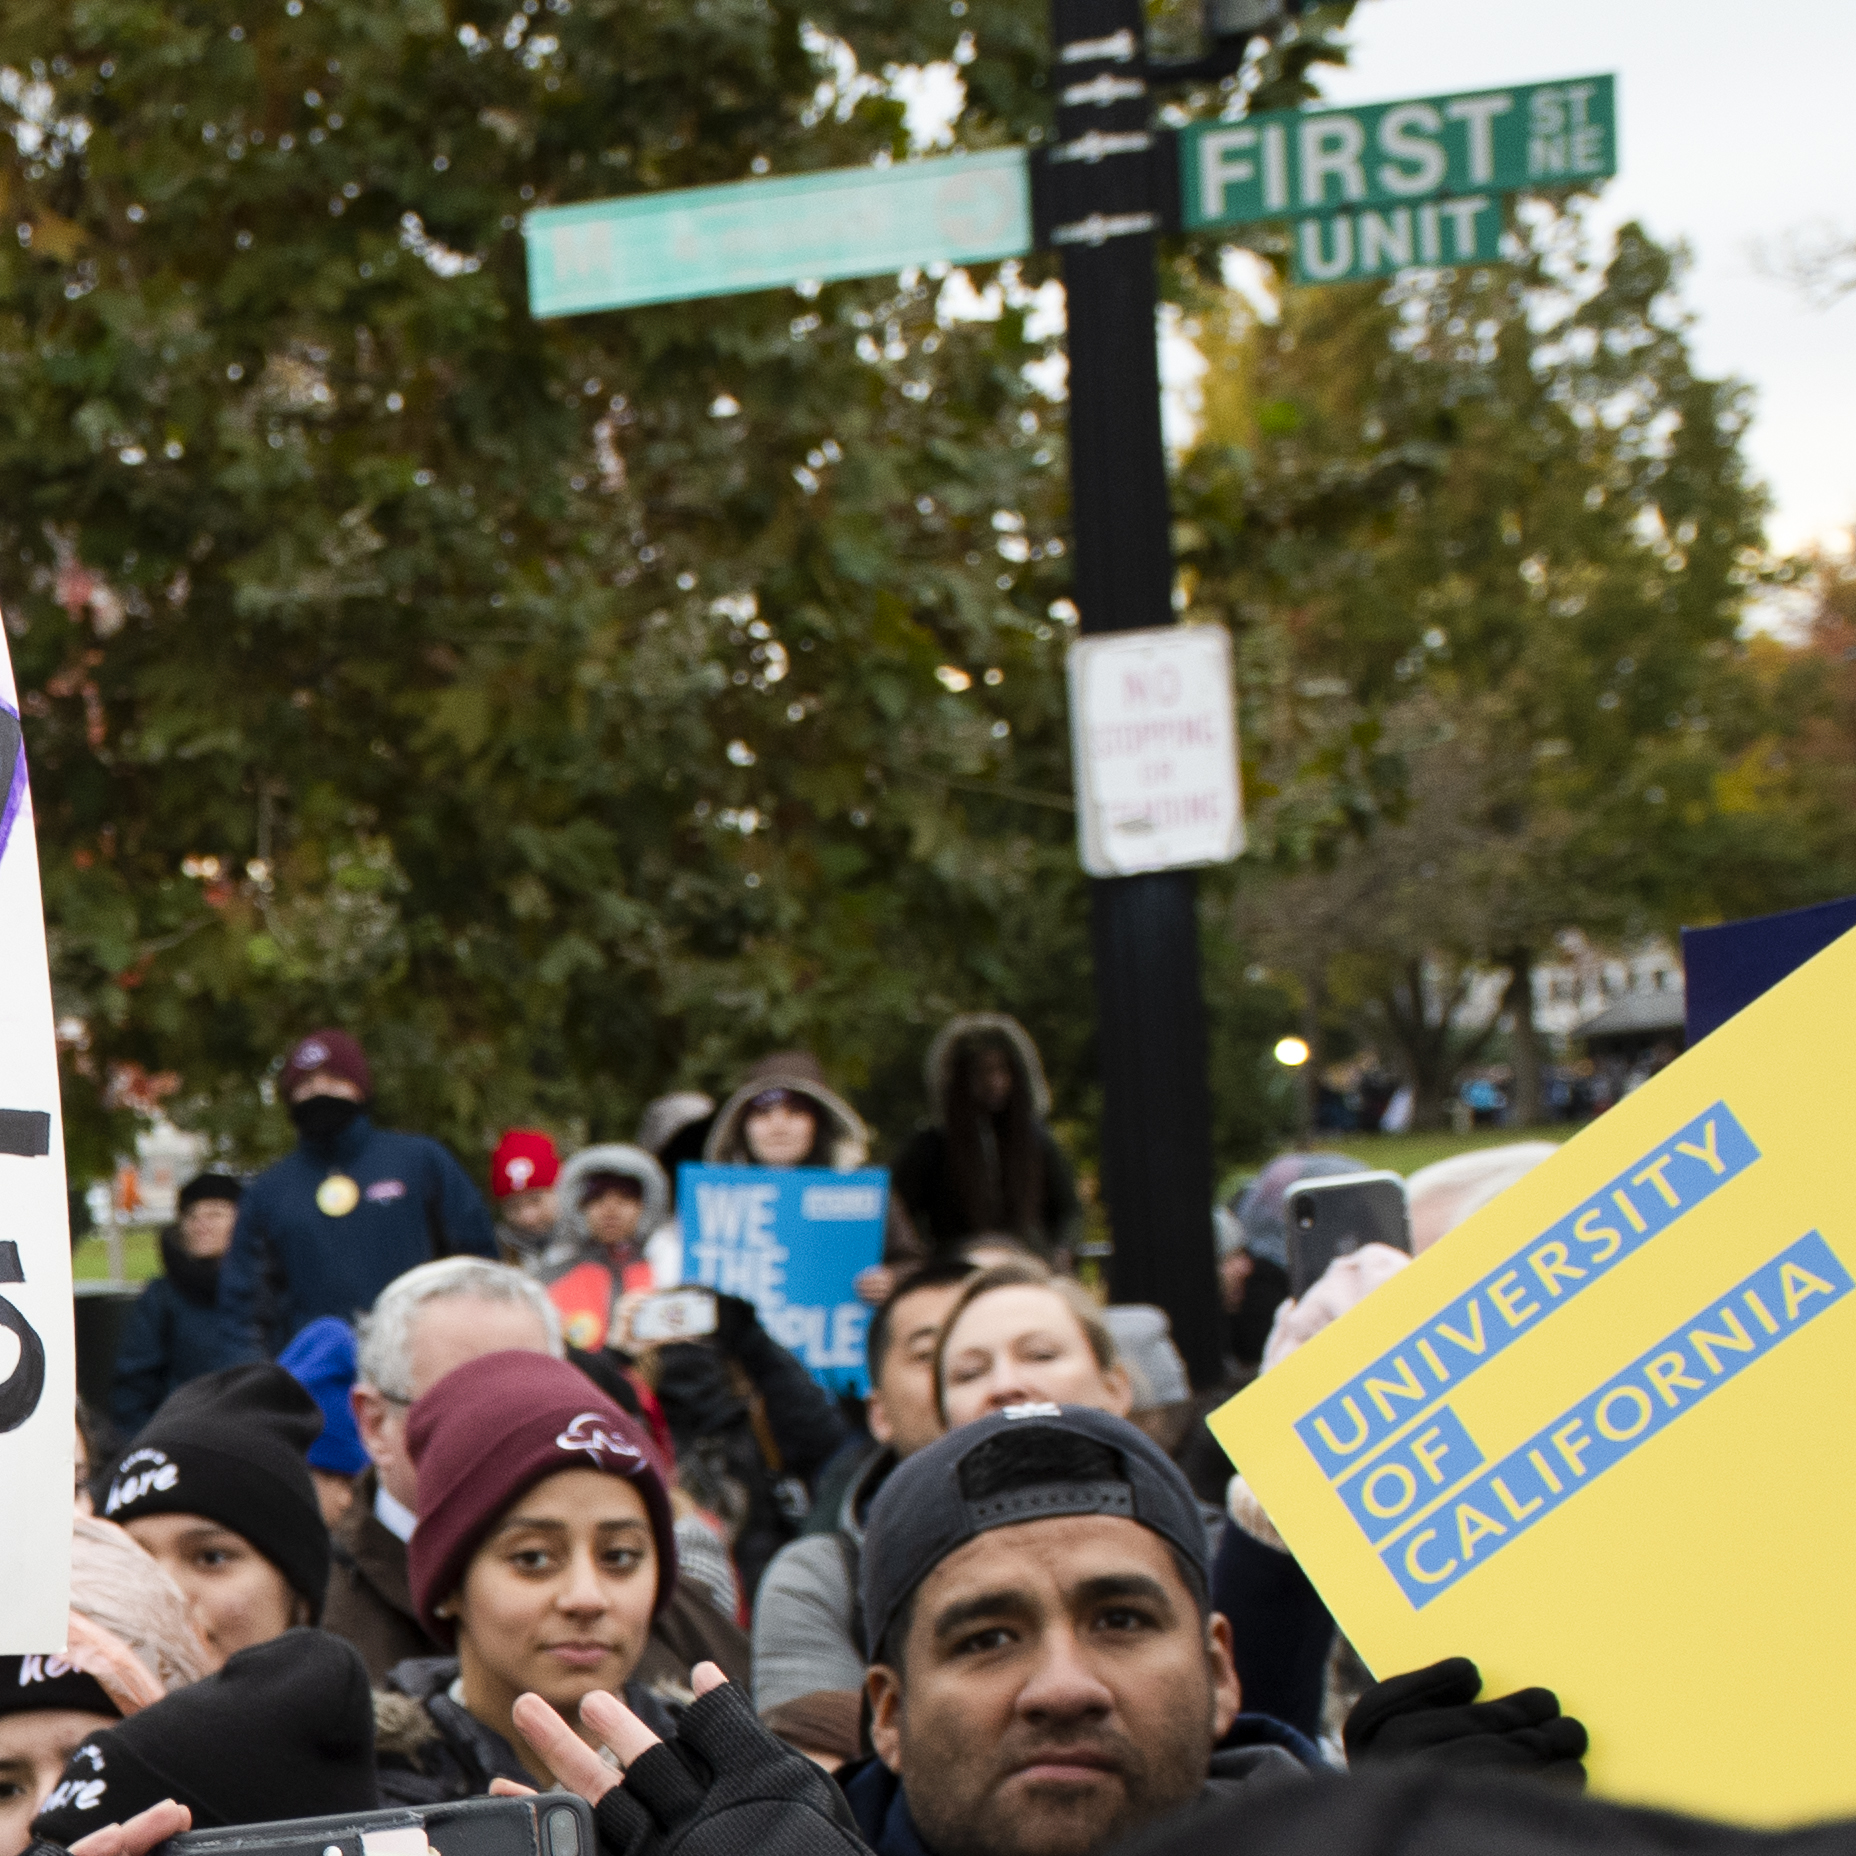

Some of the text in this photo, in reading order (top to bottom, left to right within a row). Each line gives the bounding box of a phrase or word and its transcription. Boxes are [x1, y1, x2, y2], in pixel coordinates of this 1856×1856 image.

[1527, 83, 1597, 133] ST
[1527, 124, 1606, 179] NE
[1198, 94, 1514, 219] FIRST
[1297, 196, 1488, 281] UNIT
[696, 1182, 778, 1247] WE
[1312, 1119, 1727, 1455] UNIVERSITY
[1405, 1261, 1835, 1584] CALIFORNIA
[1361, 1426, 1449, 1518] OF
